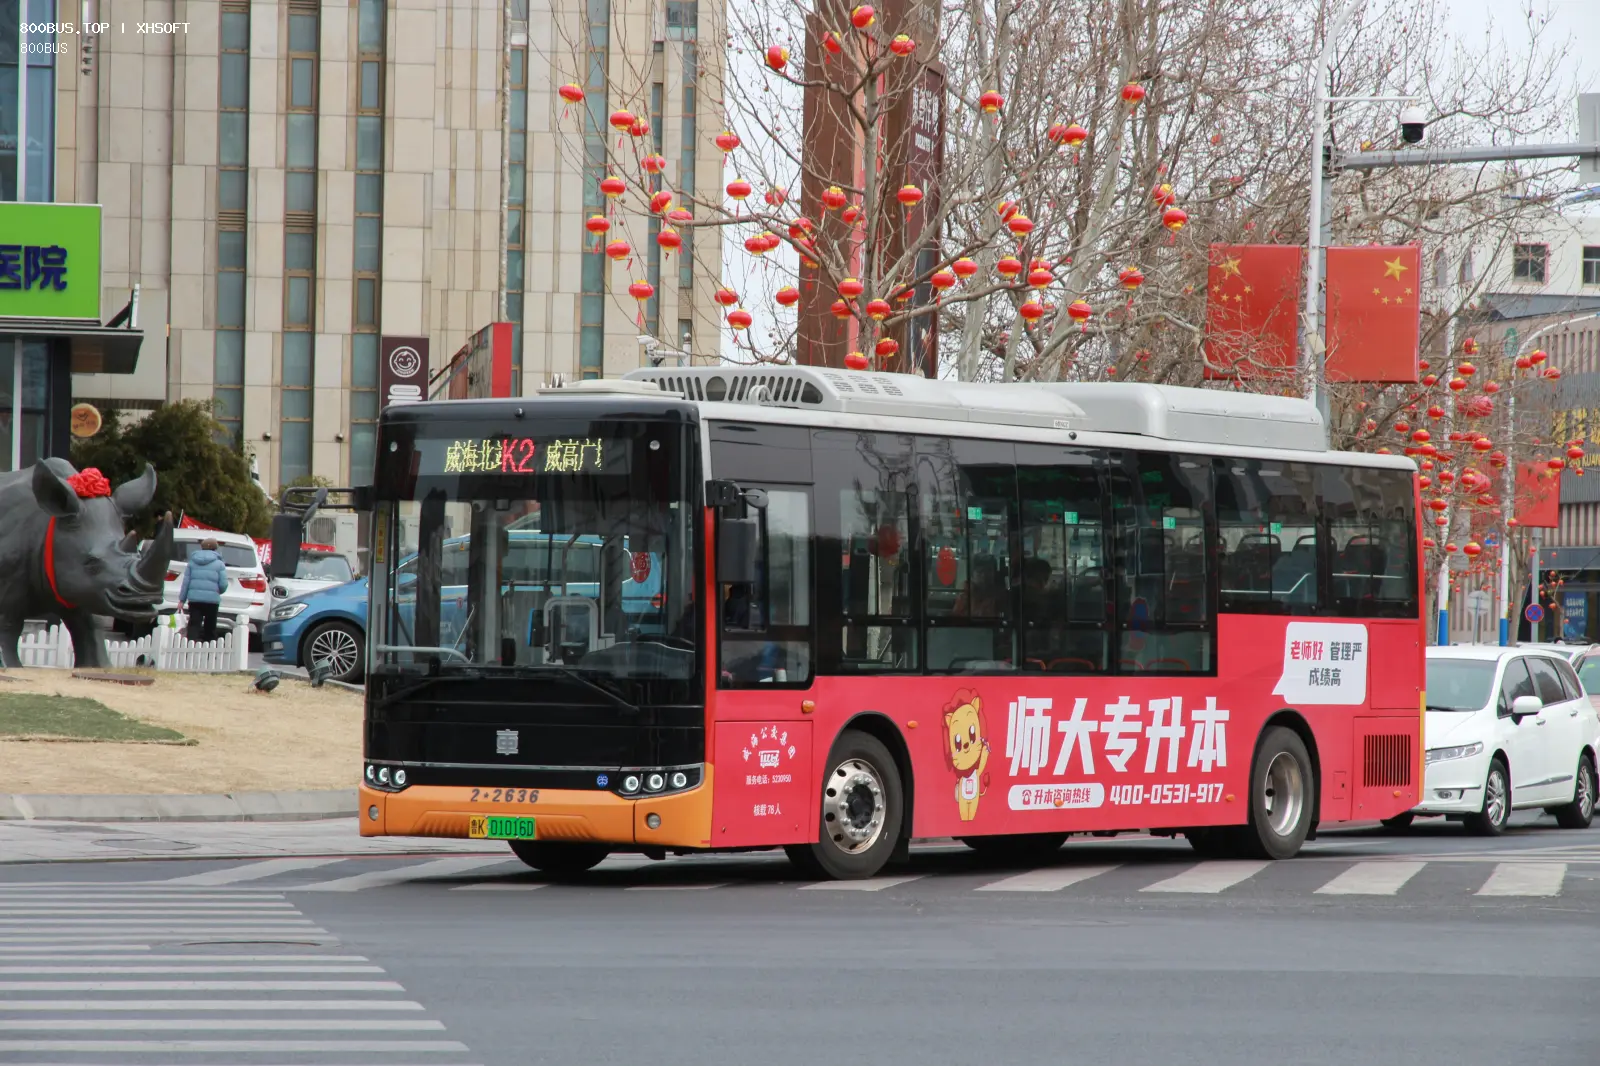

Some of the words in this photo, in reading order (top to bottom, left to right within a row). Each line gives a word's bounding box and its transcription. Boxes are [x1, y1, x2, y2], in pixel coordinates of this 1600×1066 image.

[0, 245, 67, 291] 医院
[501, 438, 535, 472] K2
[1291, 640, 1323, 661] 老师好
[1330, 641, 1362, 661] 管理严
[1309, 667, 1342, 687] 成绩高
[1005, 695, 1230, 776] 师大专升本
[1034, 788, 1091, 805] 升本咨询热线
[1110, 783, 1224, 805] 400-0531-917
[490, 820, 534, 836] 01016D
